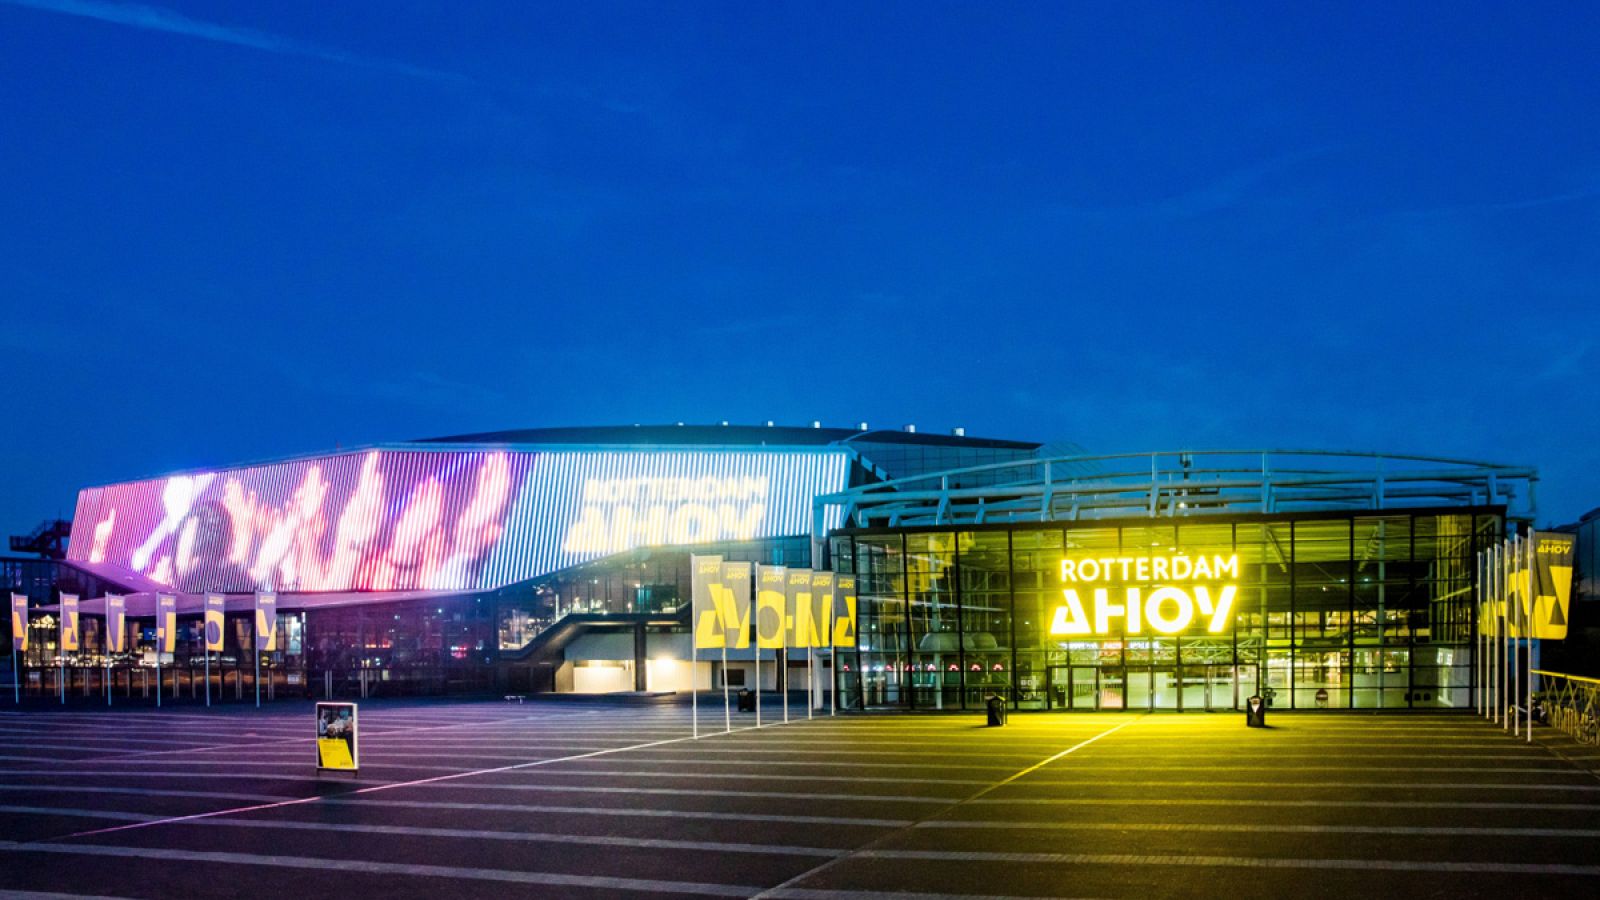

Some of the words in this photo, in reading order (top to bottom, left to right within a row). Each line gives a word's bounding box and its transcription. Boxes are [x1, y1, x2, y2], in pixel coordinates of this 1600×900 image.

[564, 503, 766, 553] AHOY
[1537, 545, 1571, 554] AHOY
[1061, 555, 1239, 582] ROTTERDAM
[1050, 586, 1238, 634] AHOY
